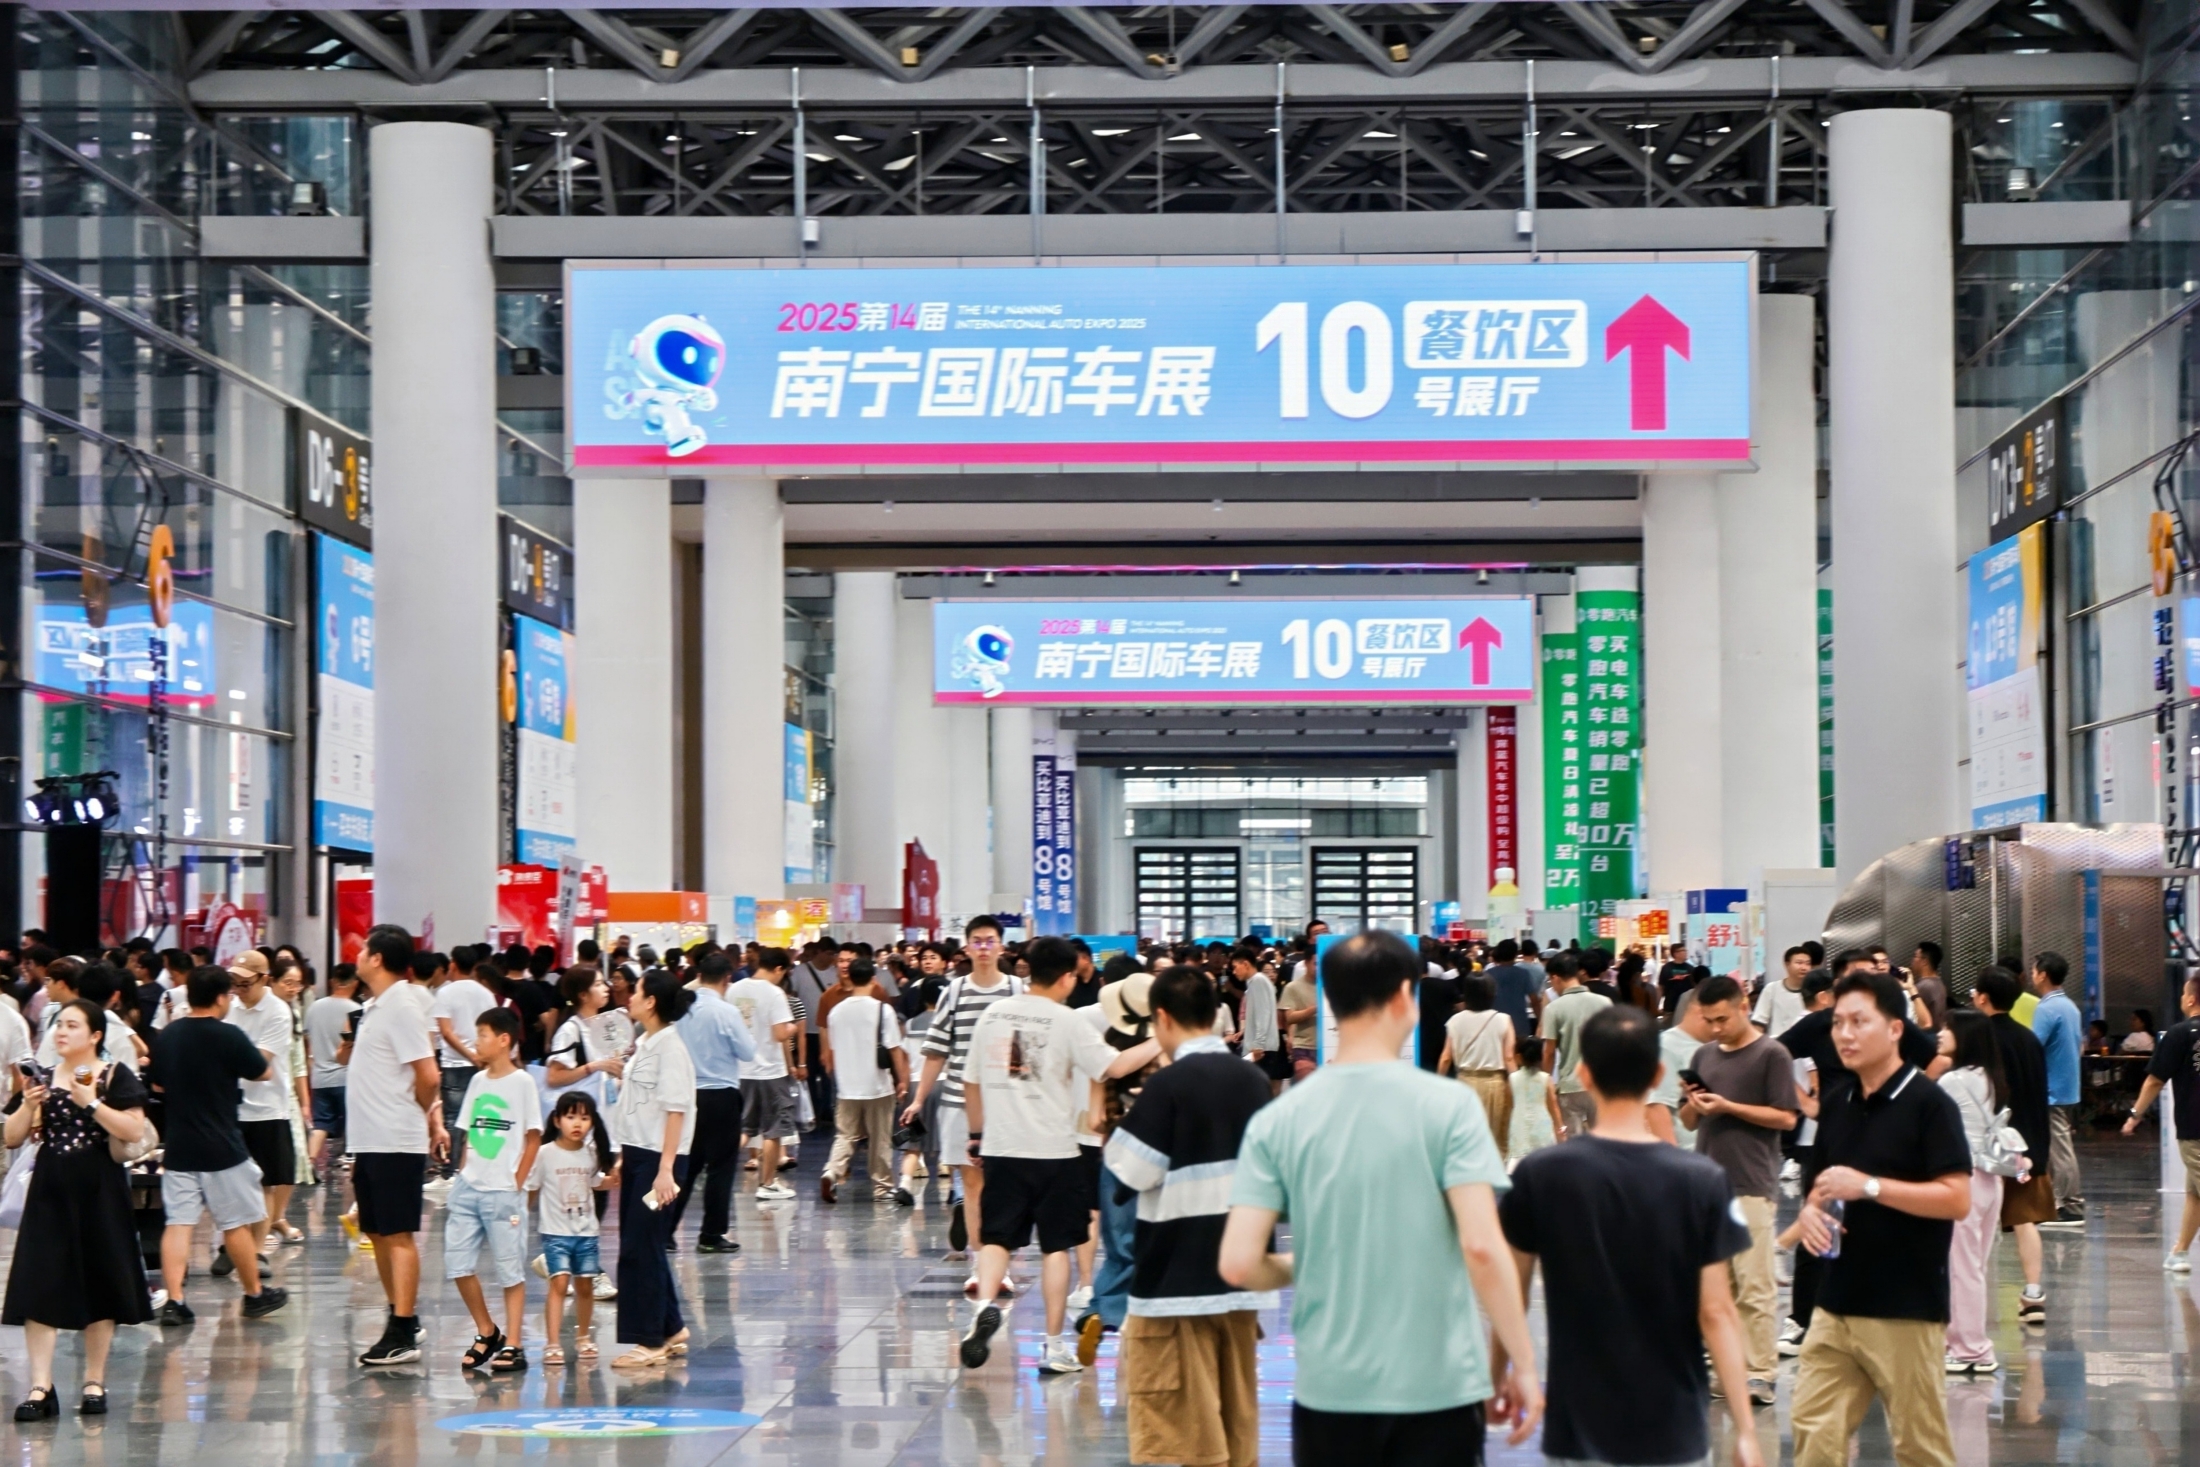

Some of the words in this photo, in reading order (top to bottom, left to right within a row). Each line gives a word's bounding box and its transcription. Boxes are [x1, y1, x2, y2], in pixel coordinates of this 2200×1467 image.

[776, 302, 949, 332] 2025第14届
[954, 318, 1050, 330] INTERNATIONAL
[1050, 318, 1083, 330] AUTO
[1084, 318, 1117, 329] EXPO
[957, 304, 982, 315] THE
[1004, 304, 1063, 315] NANNING
[1419, 308, 1580, 361] 餐饮区
[1256, 300, 1394, 420] 10
[770, 345, 1216, 419] 南宁国际车展
[1413, 376, 1540, 417] 号展厅
[1281, 618, 1353, 679] 10
[1365, 623, 1445, 649] 餐饮区
[1034, 641, 1262, 680] 南宁国际车展
[1361, 657, 1428, 678] 号展厅
[1610, 636, 1630, 771] 买电车选零跑
